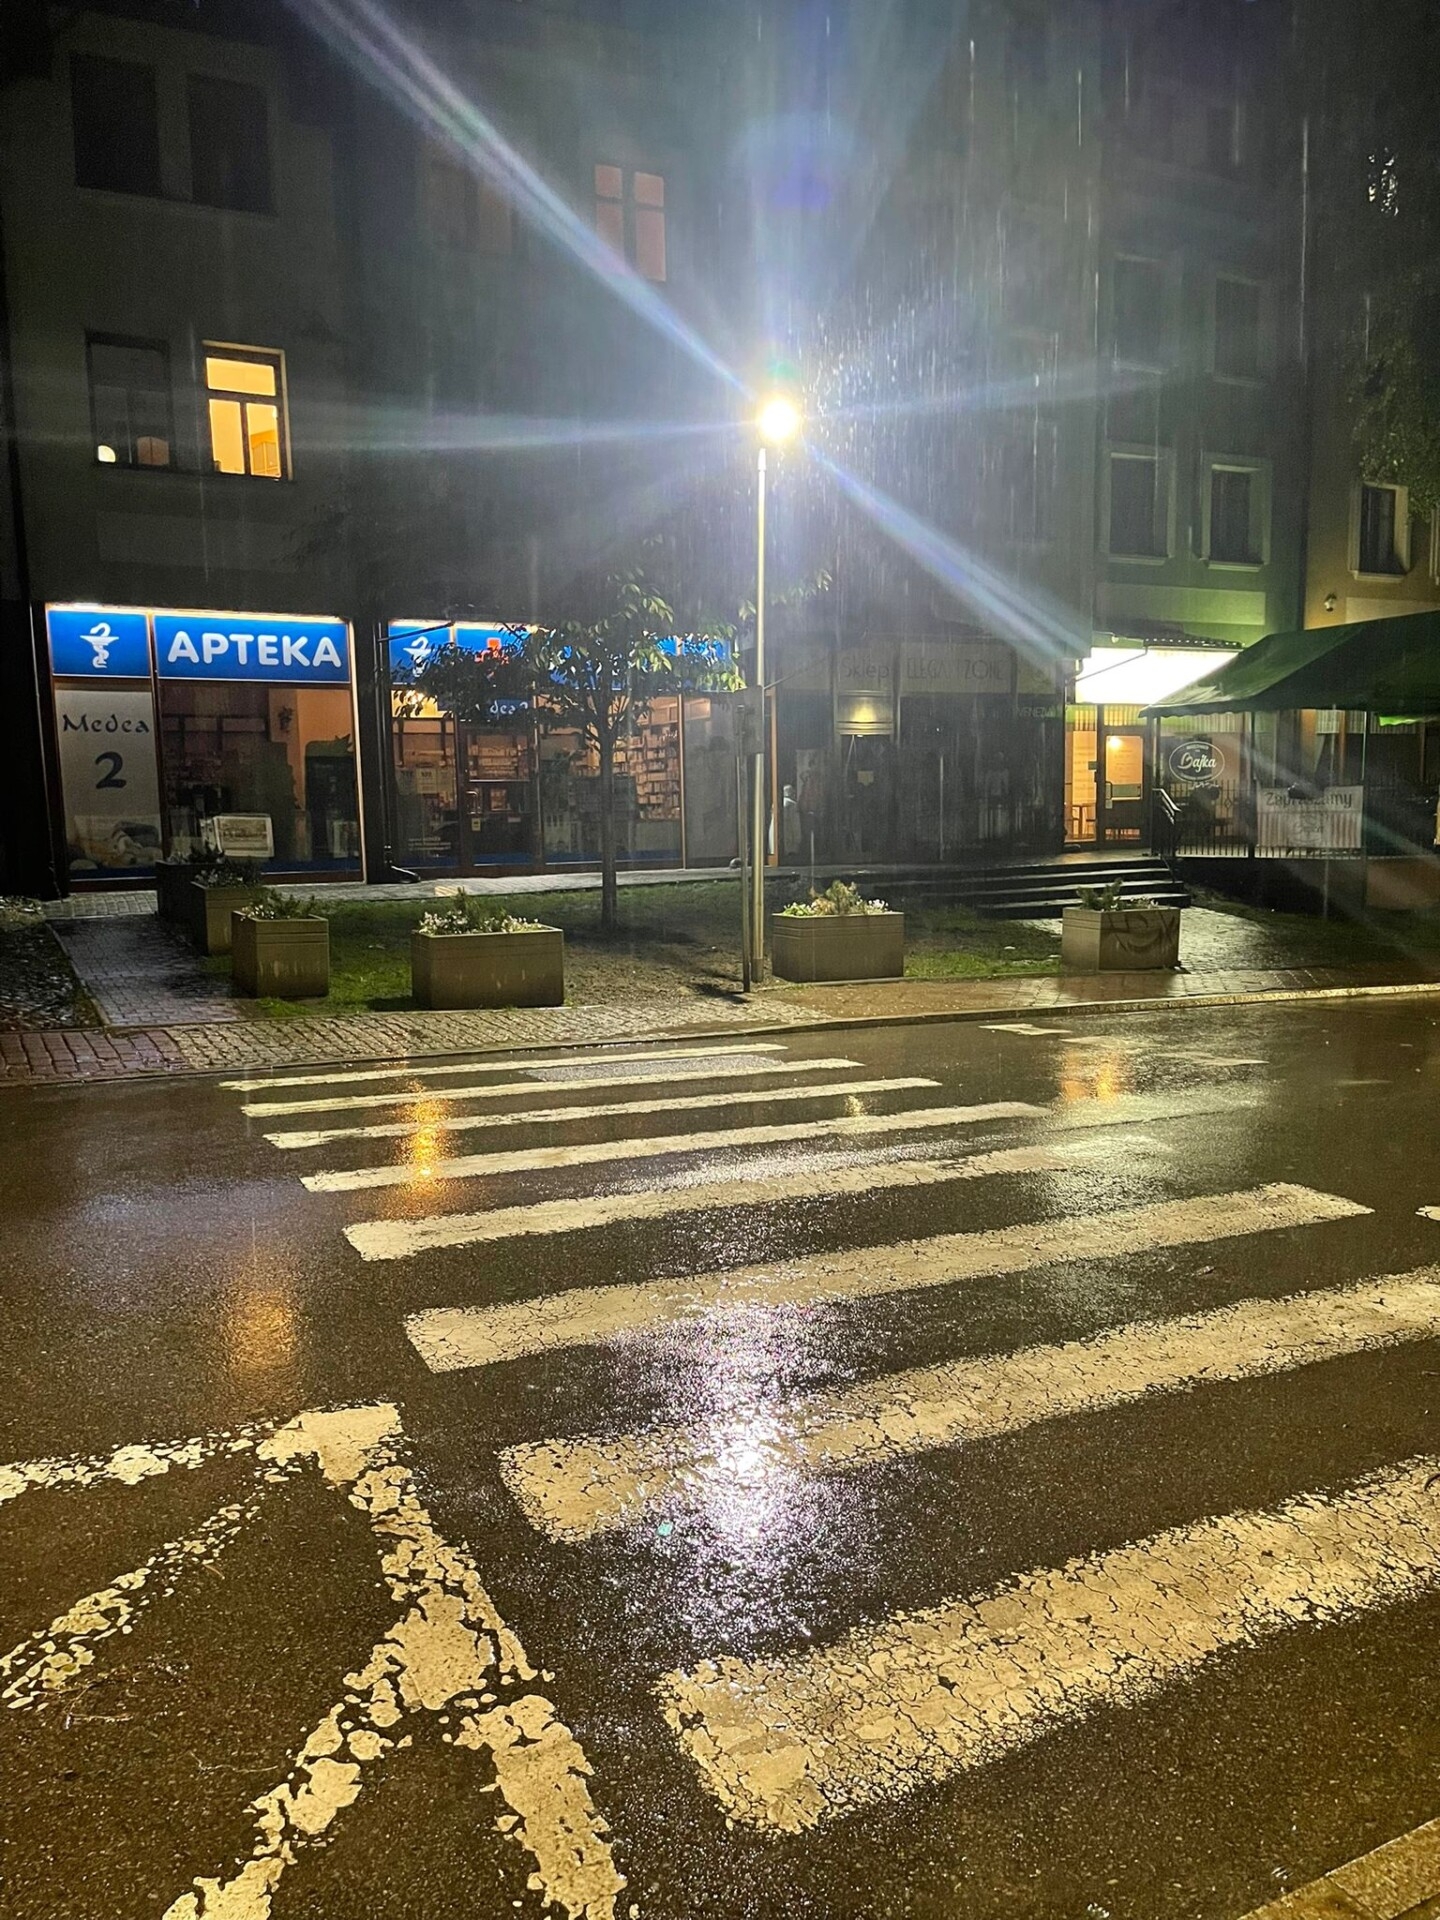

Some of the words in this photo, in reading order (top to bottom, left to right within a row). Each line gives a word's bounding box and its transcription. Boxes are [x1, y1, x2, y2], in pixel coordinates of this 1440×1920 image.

[168, 631, 342, 667] APTEKA
[841, 655, 889, 687] Sklep
[63, 714, 149, 733] Medea
[95, 751, 126, 790] 2
[1177, 752, 1217, 773] Bajka
